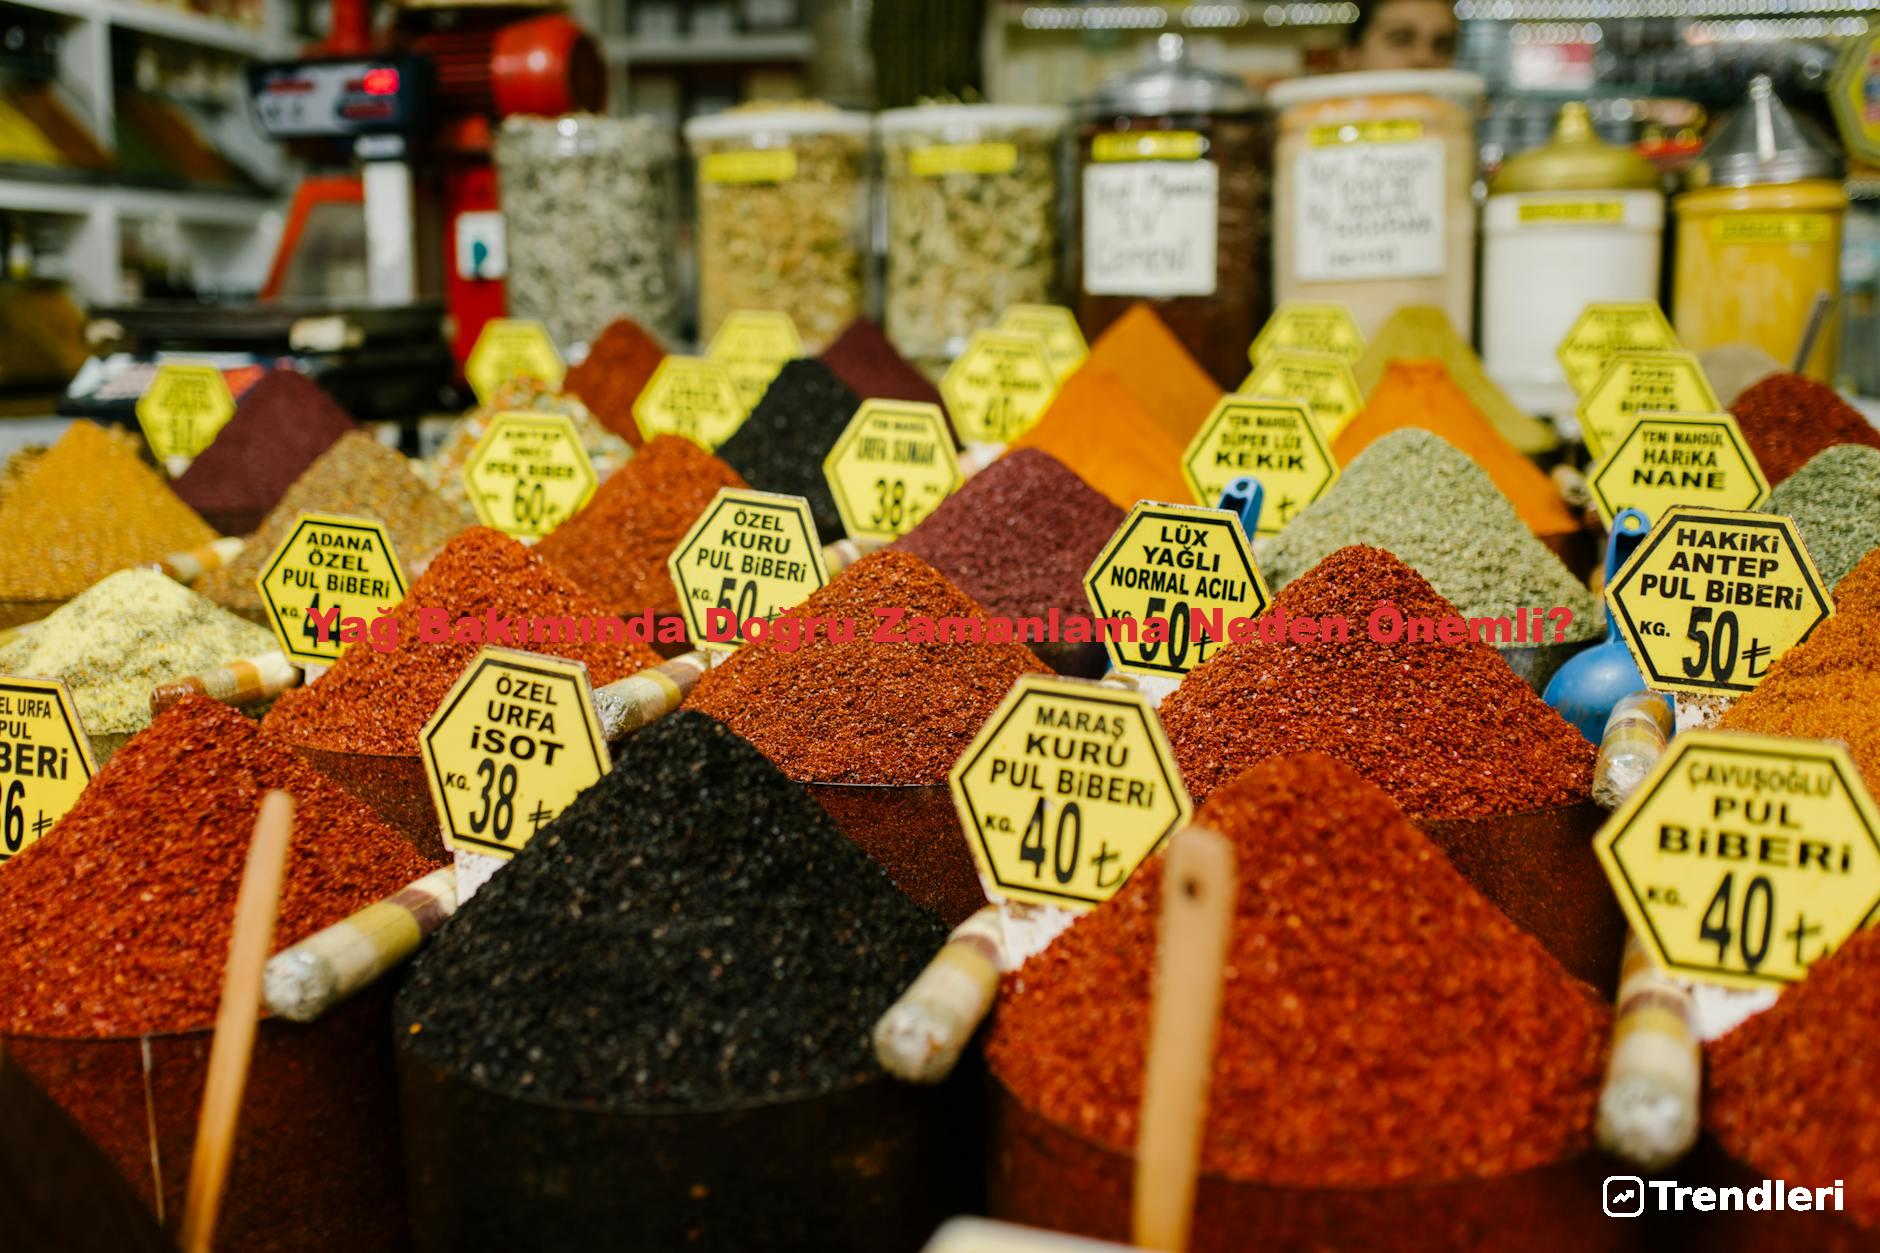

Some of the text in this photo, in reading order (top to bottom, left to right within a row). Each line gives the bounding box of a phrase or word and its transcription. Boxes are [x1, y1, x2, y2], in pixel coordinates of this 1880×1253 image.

[1215, 451, 1305, 471] KEKiK
[1643, 448, 1718, 467] HARiKA
[1633, 469, 1726, 490] NANE
[513, 477, 545, 526] 60
[872, 479, 905, 527] 38
[733, 507, 785, 532] ÖZEL
[1160, 523, 1209, 547] LÜX
[306, 532, 373, 552] ADANA
[721, 529, 791, 555] KURU
[1676, 528, 1780, 554] HAKiKi
[308, 547, 369, 573] ÖZEL
[697, 548, 807, 583] PUL BiBERi
[1142, 545, 1220, 573] YAĞLI
[1668, 551, 1780, 579] ANTEP
[282, 568, 391, 599] PUL BiBERi
[1111, 565, 1247, 603] NORMAL ACILI
[1640, 574, 1803, 611] PUL BiBERi
[1639, 620, 1671, 637] KG.
[1682, 606, 1739, 682] 50
[496, 671, 558, 706] ÖZEL
[17, 698, 52, 719] URFA
[487, 700, 555, 735] URFA
[1035, 706, 1125, 742] MARAŞ
[0, 720, 32, 740] PUL
[470, 725, 565, 766] iSOT
[1025, 732, 1128, 768] KURU
[989, 759, 1155, 808] PUL BiBERi
[1688, 761, 1834, 798] ÇAVUŞOĞLU
[0, 779, 26, 853] 6
[469, 757, 518, 842] 38
[1712, 796, 1803, 830] PUL
[1019, 796, 1081, 884] 40
[1658, 825, 1852, 874] BiBERi
[1700, 871, 1775, 975] 40
